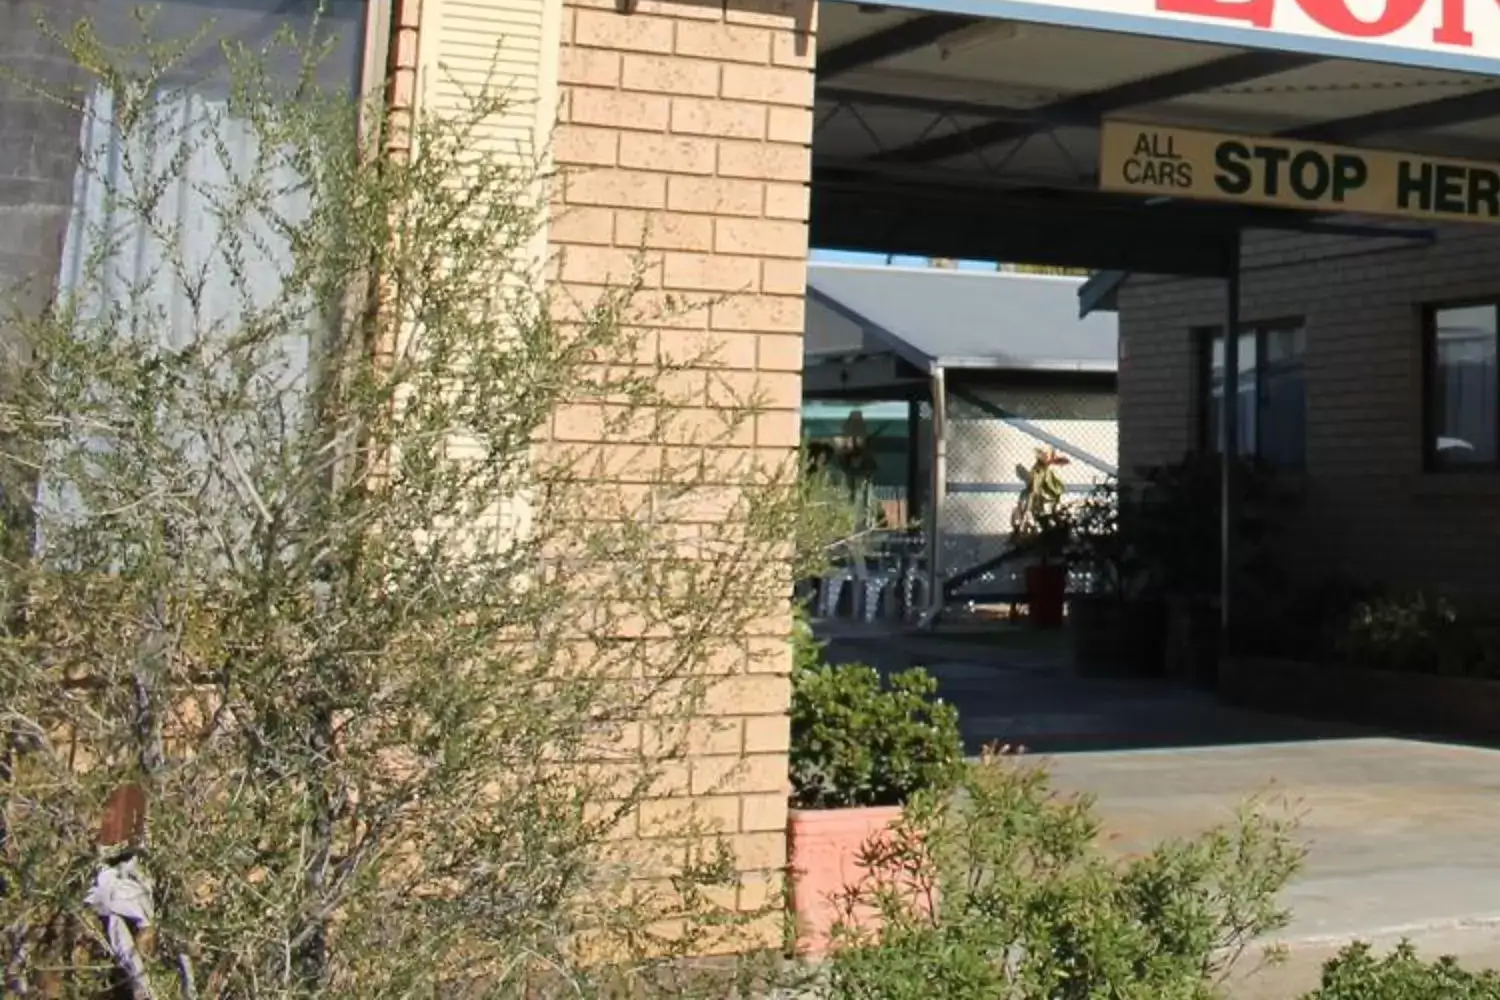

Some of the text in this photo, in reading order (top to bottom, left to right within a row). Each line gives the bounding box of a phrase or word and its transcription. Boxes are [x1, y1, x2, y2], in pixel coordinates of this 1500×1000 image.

[1133, 131, 1182, 160] ALL
[1122, 158, 1193, 188] CARS
[1214, 140, 1368, 202] STOP
